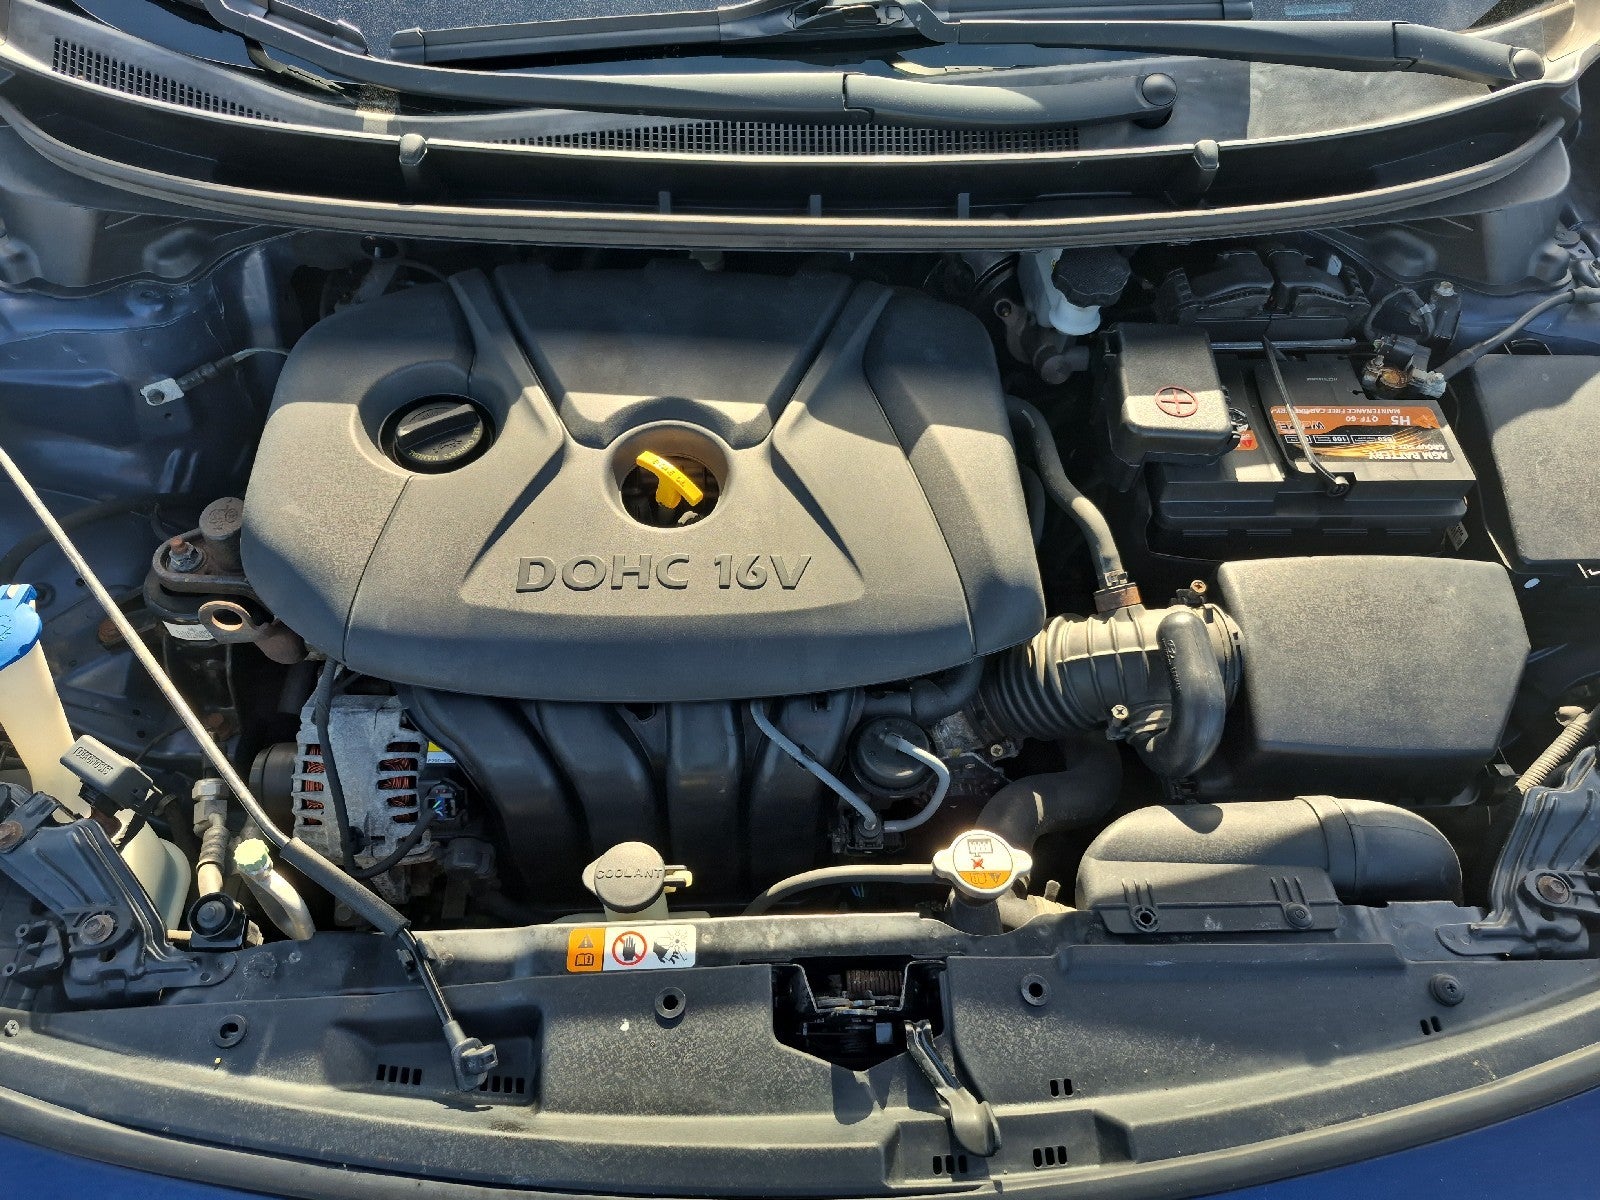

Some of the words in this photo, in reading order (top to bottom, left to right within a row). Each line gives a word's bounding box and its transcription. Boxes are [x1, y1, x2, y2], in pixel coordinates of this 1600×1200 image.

[1345, 415, 1379, 423] QTF-60
[1390, 415, 1411, 426] H5
[470, 427, 481, 439] SEE
[1415, 443, 1446, 451] GROUP
[408, 449, 440, 461] MANUAL
[1368, 450, 1421, 460] BATTERY
[1420, 451, 1449, 460] AGM
[515, 553, 690, 593] DOHC
[714, 553, 812, 591] 16V
[595, 868, 663, 880] COOLANT
